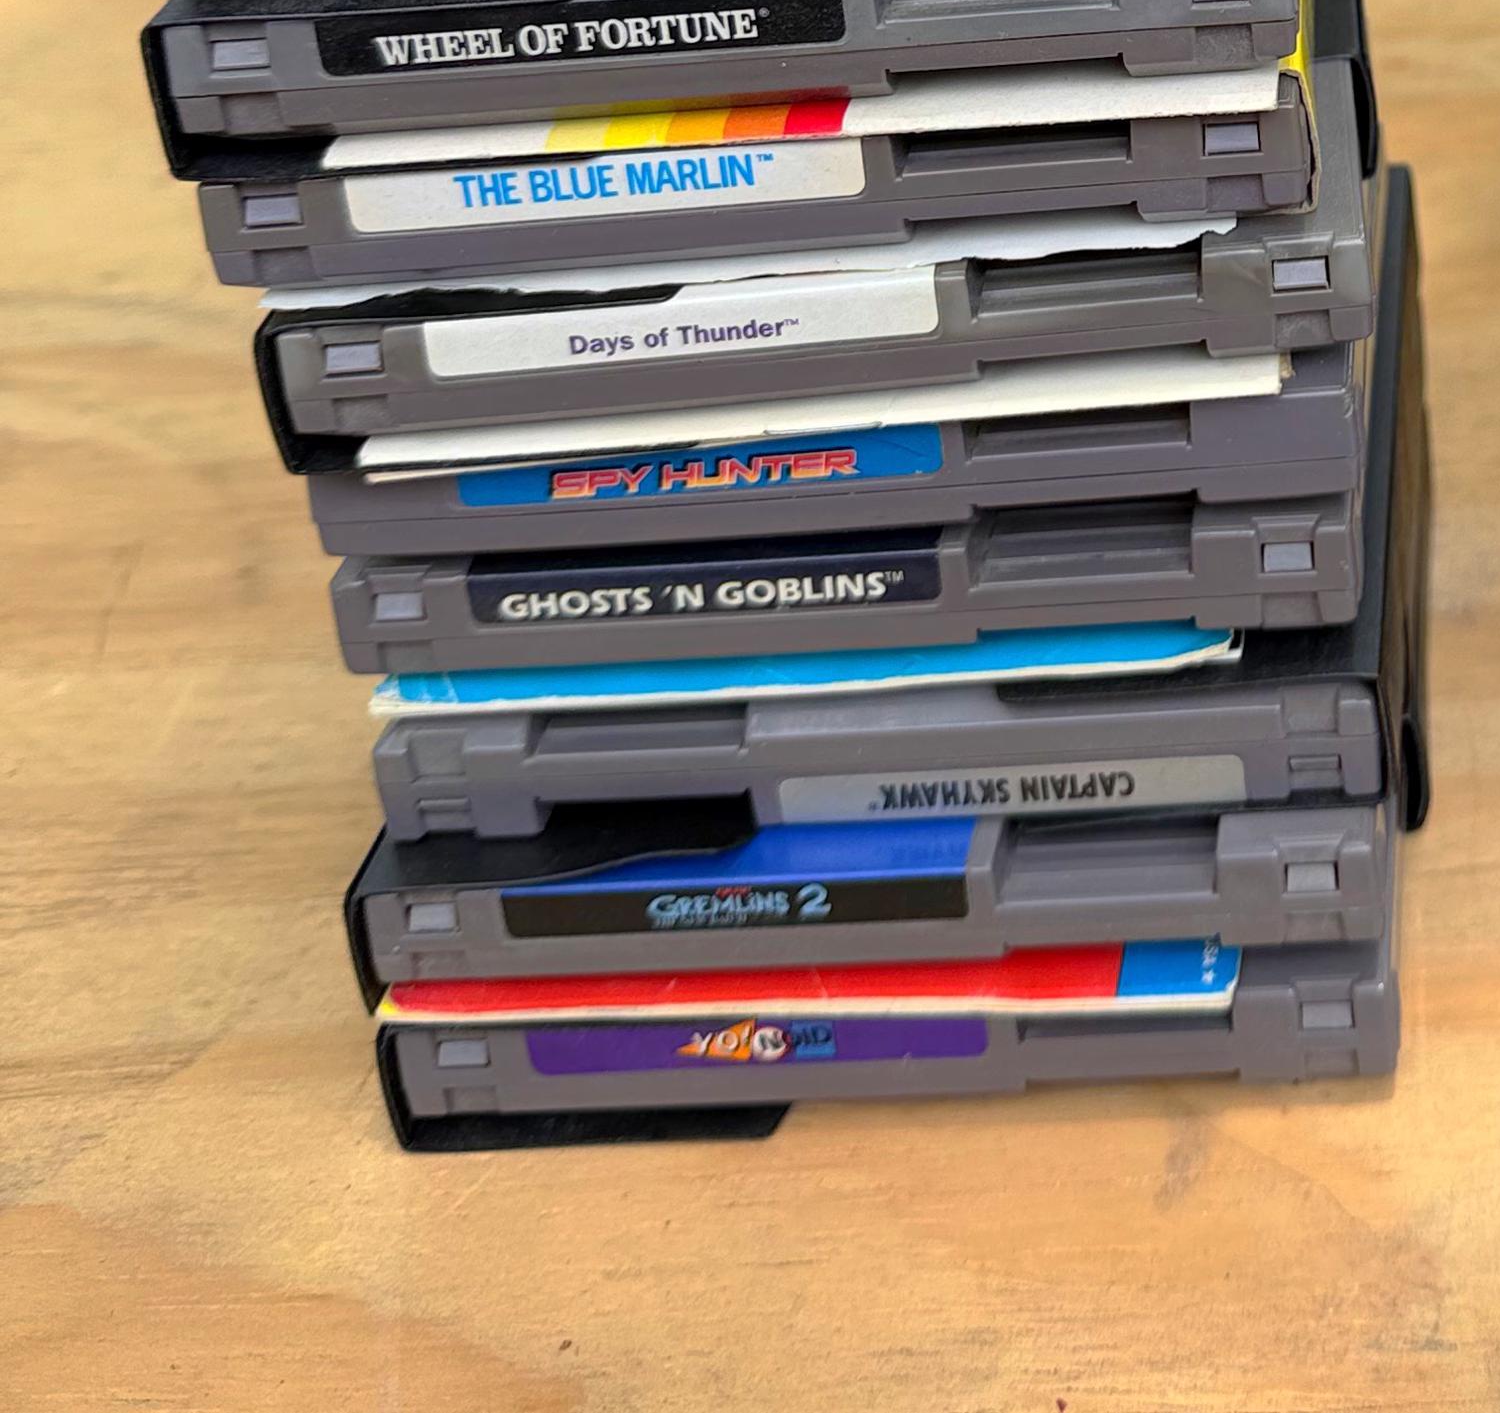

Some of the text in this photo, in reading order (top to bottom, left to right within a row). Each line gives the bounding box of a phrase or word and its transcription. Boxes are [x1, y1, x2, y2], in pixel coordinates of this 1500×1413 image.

[373, 29, 516, 67] WHEEL
[519, 21, 565, 56] OF
[454, 172, 521, 209] THE
[532, 163, 617, 203] BLUE
[569, 329, 634, 357] Days
[643, 327, 669, 349] of
[550, 447, 858, 500] SPY HUNTER
[500, 585, 652, 622] GHOSTS
[1020, 770, 1136, 803] CAPTAIN
[796, 882, 833, 919] 2
